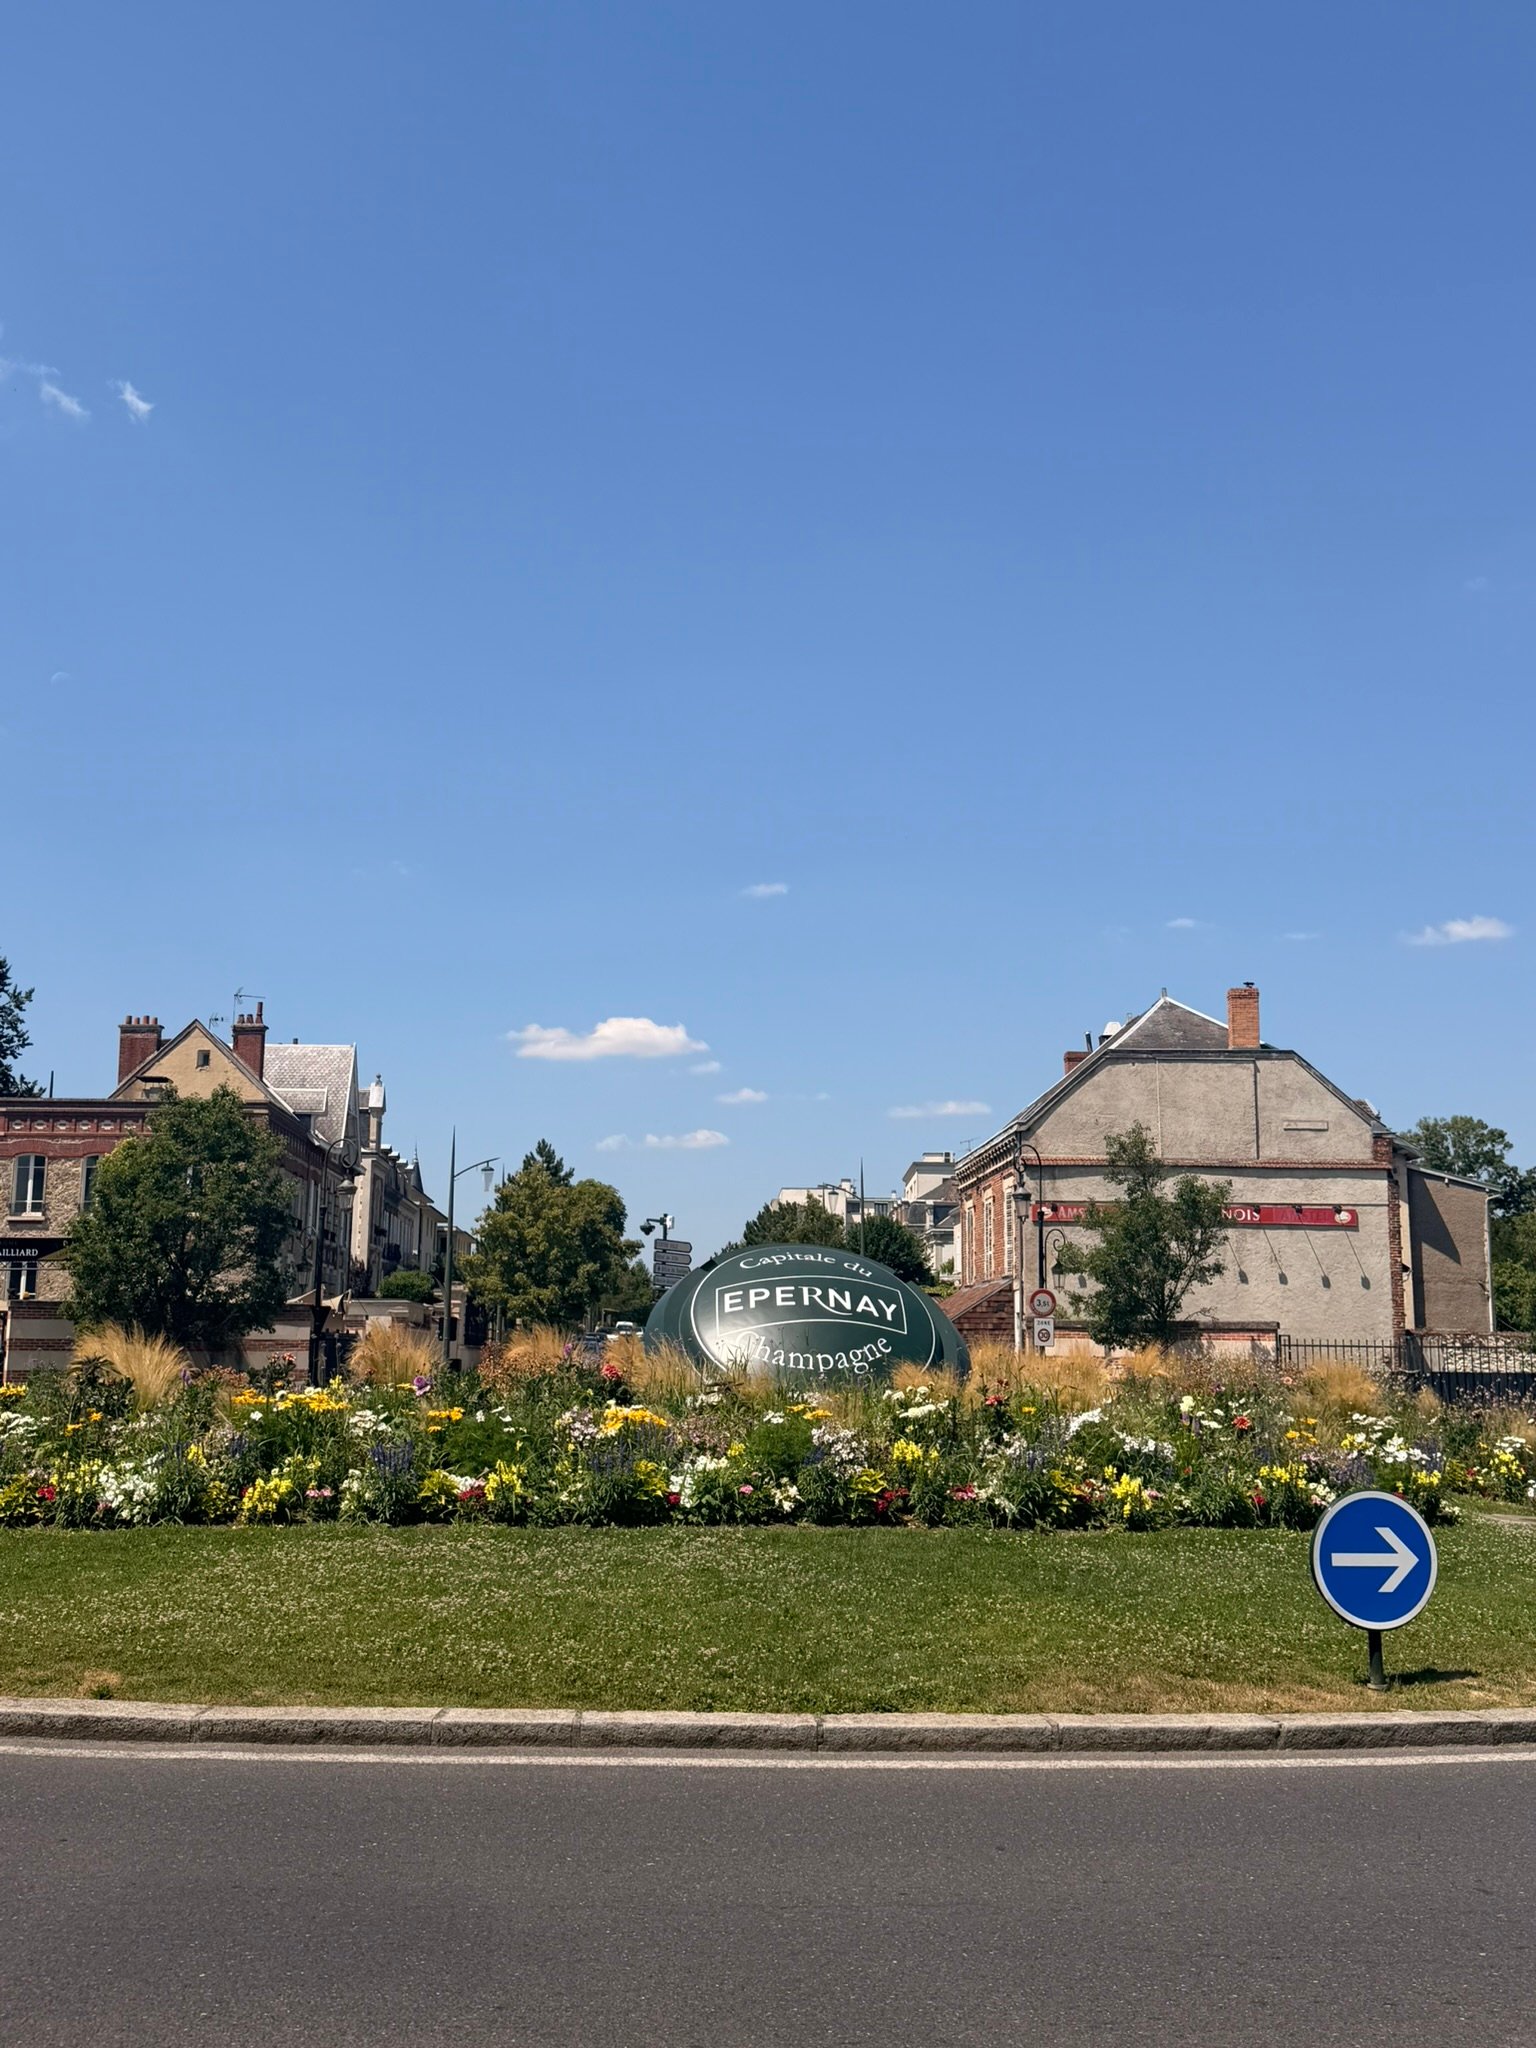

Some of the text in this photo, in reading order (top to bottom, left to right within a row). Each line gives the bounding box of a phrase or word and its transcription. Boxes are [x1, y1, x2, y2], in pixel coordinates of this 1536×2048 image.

[1058, 1206, 1086, 1219] AMS
[1221, 1208, 1260, 1221] NOIS
[0, 1248, 39, 1257] ILLIARD
[739, 1252, 873, 1278] Capitale du
[724, 1286, 897, 1321] EPERNAY
